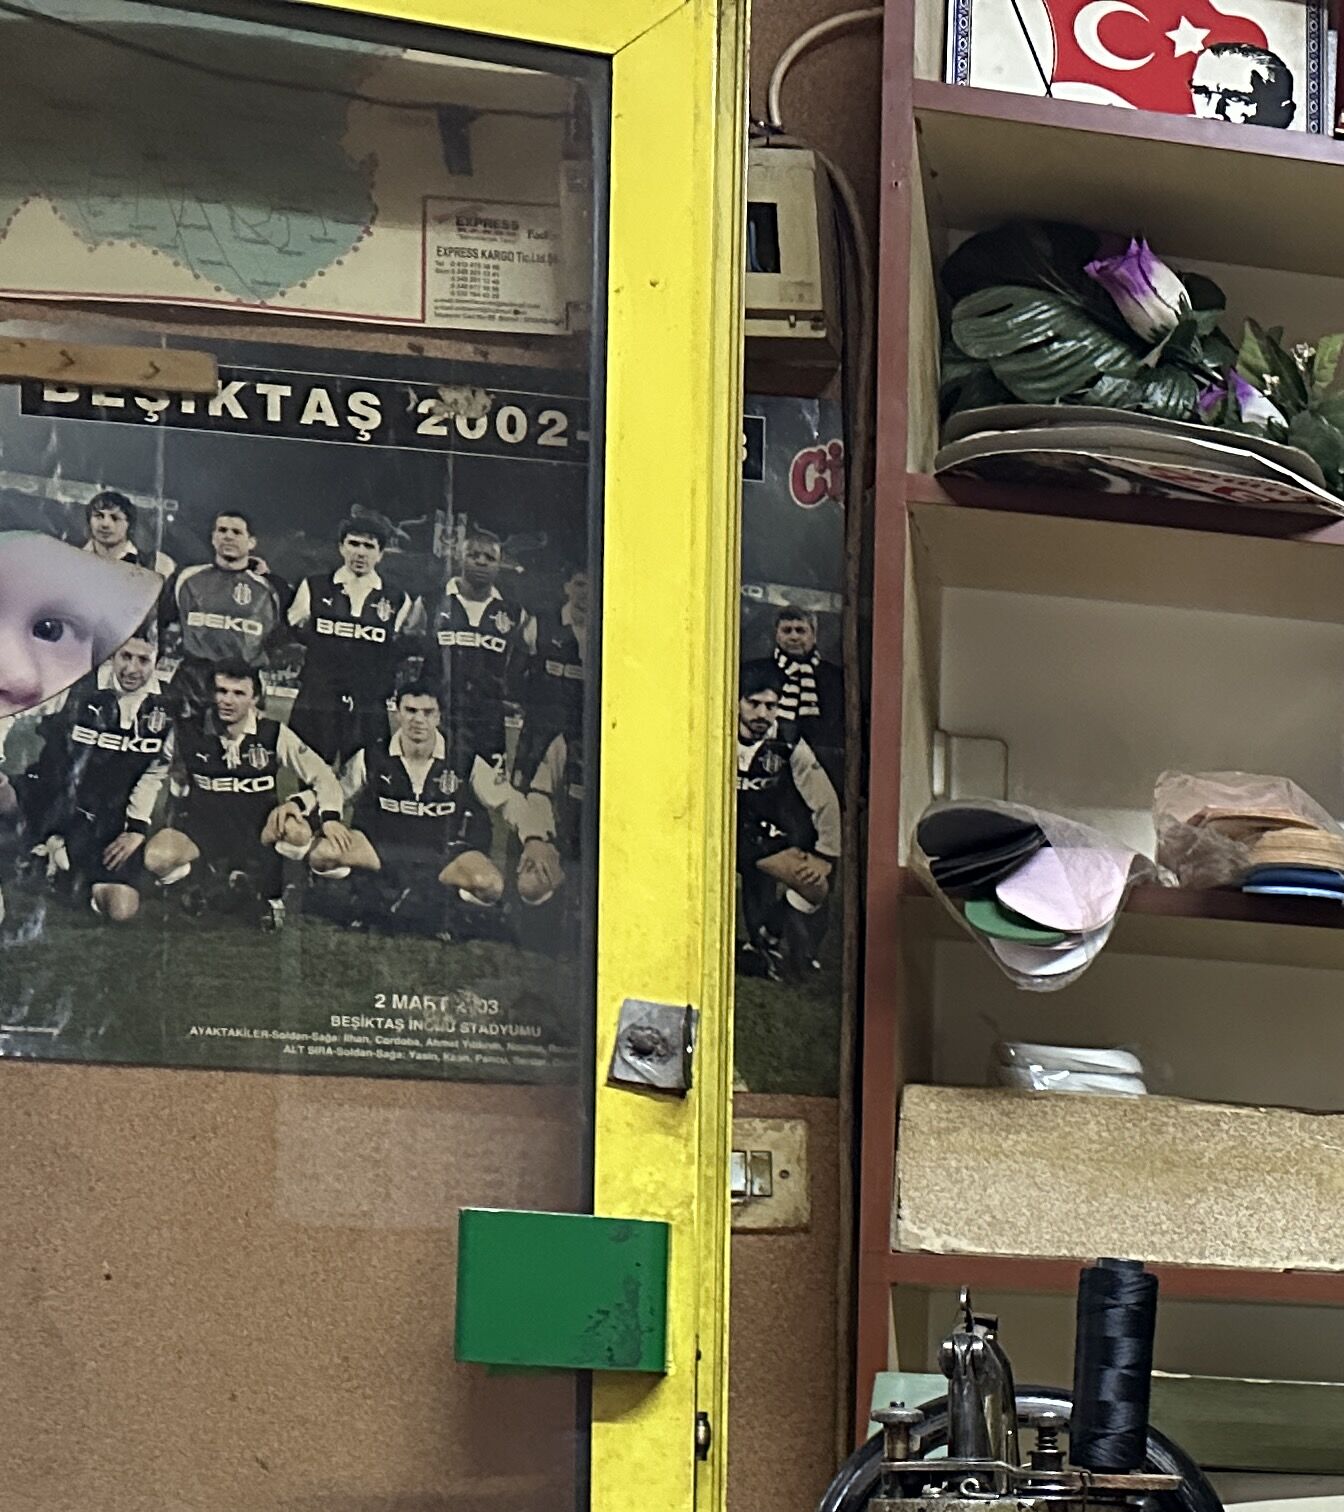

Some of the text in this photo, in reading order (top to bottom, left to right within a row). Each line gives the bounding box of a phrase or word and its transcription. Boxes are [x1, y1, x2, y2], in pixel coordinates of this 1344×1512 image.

[437, 246, 479, 259] EXPRESS
[481, 249, 515, 262] KARGO
[187, 610, 263, 636] BEKO
[316, 617, 386, 643] BEKO
[437, 630, 507, 653] BEKO
[71, 724, 162, 754] BEKO
[193, 773, 274, 794] BEKO
[379, 796, 456, 818] BEKO
[375, 994, 386, 1009] 2
[331, 1014, 404, 1033] BEŞİKTAŞ
[460, 1022, 541, 1038] STADYUMU
[283, 1045, 304, 1055] ALT
